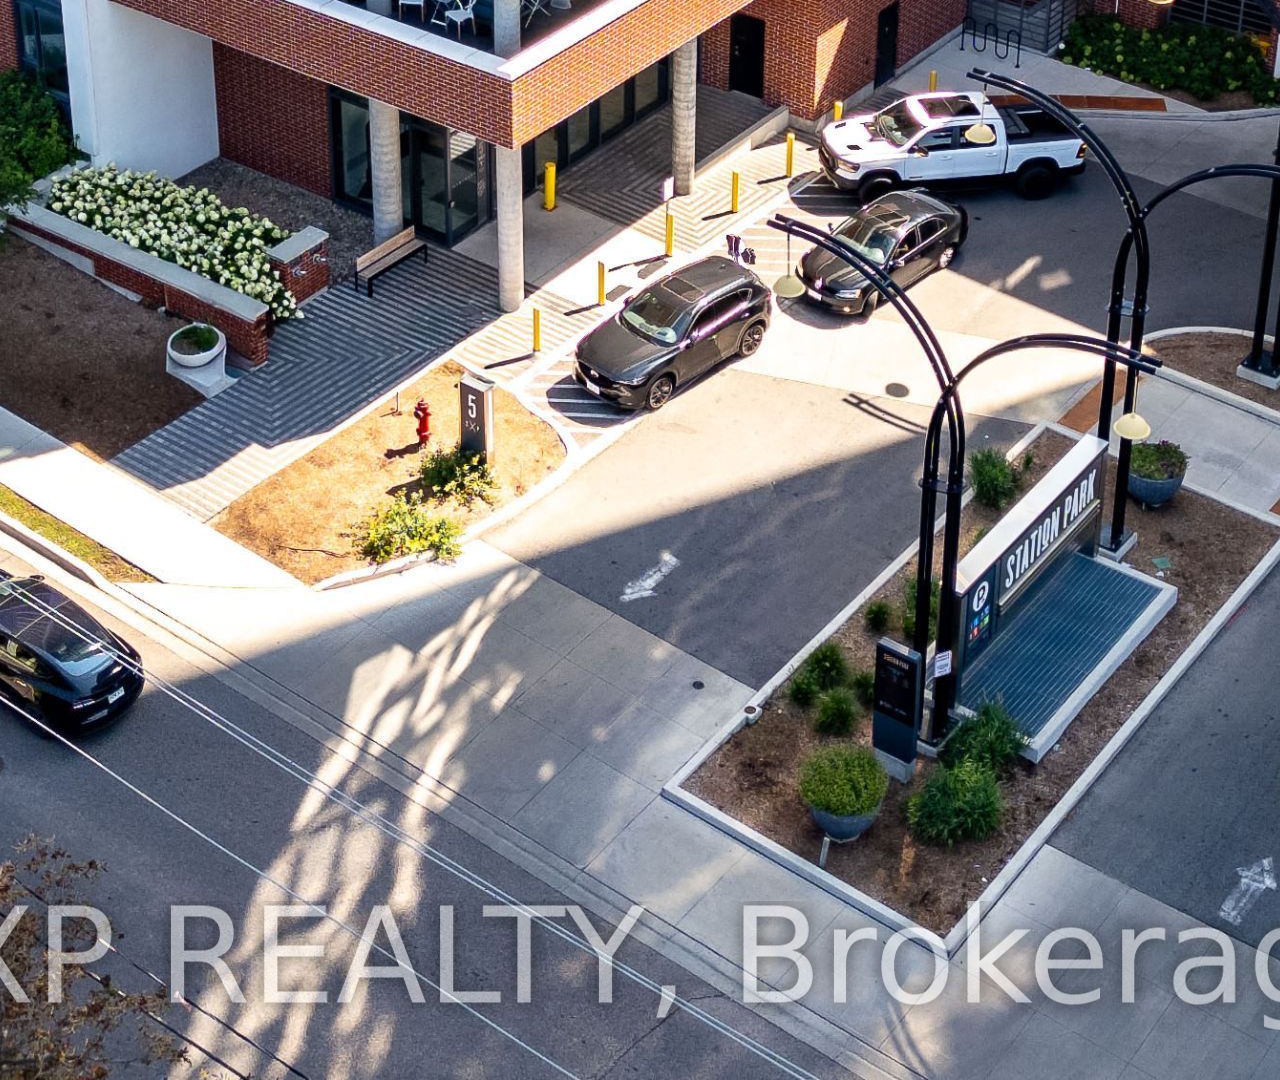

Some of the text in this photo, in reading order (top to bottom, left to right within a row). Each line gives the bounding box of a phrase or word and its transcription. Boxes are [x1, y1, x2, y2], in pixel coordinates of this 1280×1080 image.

[467, 394, 477, 418] 5
[1005, 468, 1097, 589] STATION PARK
